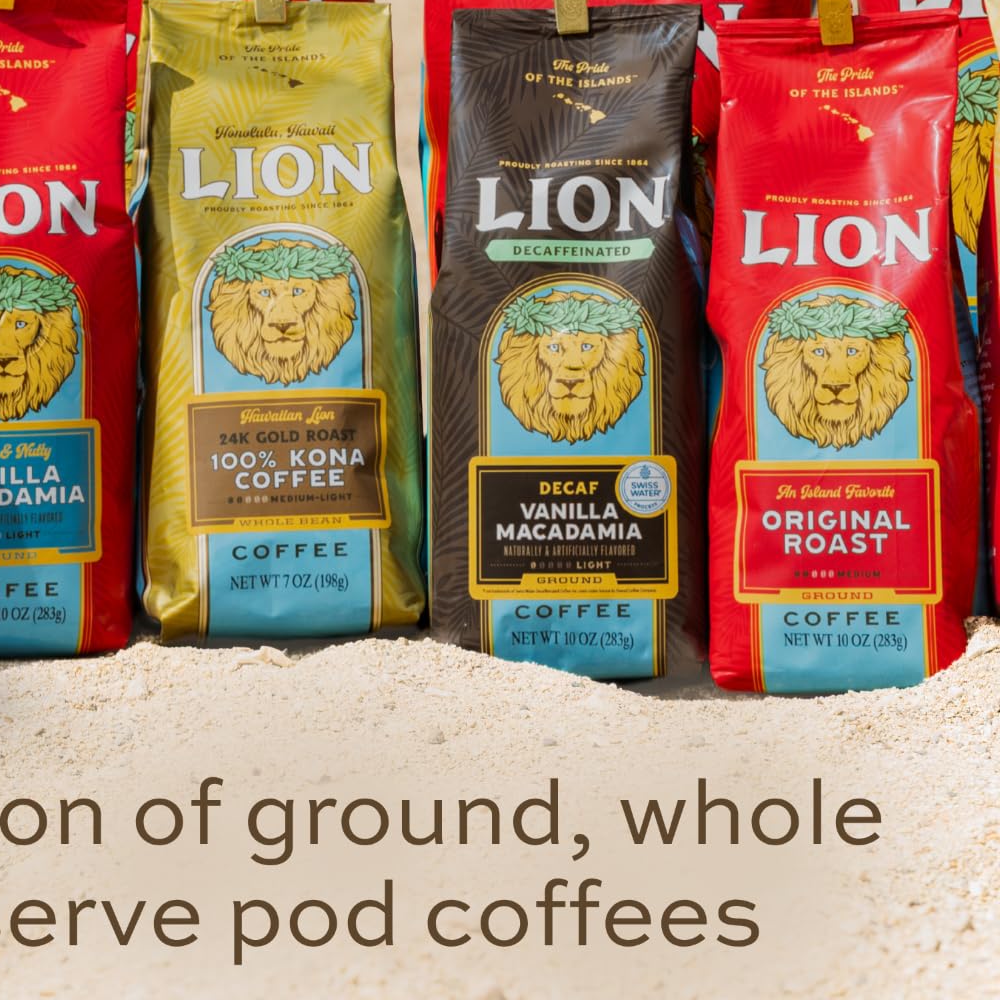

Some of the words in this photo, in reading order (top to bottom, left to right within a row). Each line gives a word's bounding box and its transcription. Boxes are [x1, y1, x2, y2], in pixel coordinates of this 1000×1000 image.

[553, 59, 574, 71] The
[576, 61, 610, 73] Pride
[525, 72, 543, 82] OF
[548, 75, 573, 87] THE
[817, 68, 838, 83] The
[840, 67, 874, 82] Pride
[790, 89, 807, 97] OF
[813, 89, 838, 97] THE
[215, 125, 282, 140] Honolulu,
[287, 125, 336, 138] Hawaii
[23, 165, 51, 174] SINCE
[179, 142, 374, 200] LION
[499, 160, 540, 169] PROUDLY
[545, 159, 591, 169] ROASTING
[476, 176, 669, 233] LION
[765, 194, 808, 203] PROUDLY
[811, 198, 859, 206] ROASTING
[741, 207, 932, 267] LION
[513, 245, 631, 257] DECAFFEINATED
[240, 409, 302, 424] Hawaiian
[306, 406, 335, 424] Lion
[219, 432, 248, 445] 24K
[256, 430, 300, 443] GOLD
[307, 429, 356, 442] ROAST
[0, 444, 12, 458] &
[15, 443, 52, 461] Nutty
[210, 452, 277, 471] 100%
[290, 448, 365, 467] KONA
[235, 469, 344, 489] COFFEE
[540, 481, 599, 495] DECAF
[776, 485, 797, 499] An
[800, 484, 841, 499] Island
[845, 485, 895, 499] Favorite
[271, 493, 352, 503] MEDIUM-LIGHT
[520, 503, 619, 520] VANILLA
[239, 517, 294, 527] WHOLE
[300, 517, 343, 525] BEAN
[762, 510, 910, 530] ORIGINAL
[6, 531, 40, 539] LIGHT
[496, 523, 642, 540] MACADAMIA
[232, 542, 348, 560] COFFEE
[503, 545, 542, 557] NATURALLY
[545, 545, 550, 556] &
[552, 545, 598, 556] ARTIFICIALLY
[601, 544, 636, 556] FLAVORED
[784, 533, 888, 554] ROAST
[576, 560, 611, 569] LIGHT
[537, 576, 602, 584] GROUND
[837, 570, 880, 578] MEDIUM
[230, 575, 257, 590] NET
[260, 575, 280, 589] WT
[283, 574, 290, 588] 7
[292, 574, 312, 588] OZ
[315, 573, 349, 591] (198g)
[802, 592, 873, 600] GROUND
[11, 608, 29, 620] OZ
[32, 607, 66, 624] (283g)
[515, 604, 631, 619] COFFEE
[783, 611, 900, 626] COFFEE
[512, 631, 539, 646] NET
[542, 631, 561, 645] WT
[564, 632, 575, 645] 10
[578, 632, 598, 646] OZ
[601, 632, 634, 650] (283g)
[784, 633, 810, 646] NET
[813, 633, 833, 646] WT
[837, 634, 849, 646] 10
[852, 634, 871, 647] OZ
[873, 633, 908, 651] (283g)
